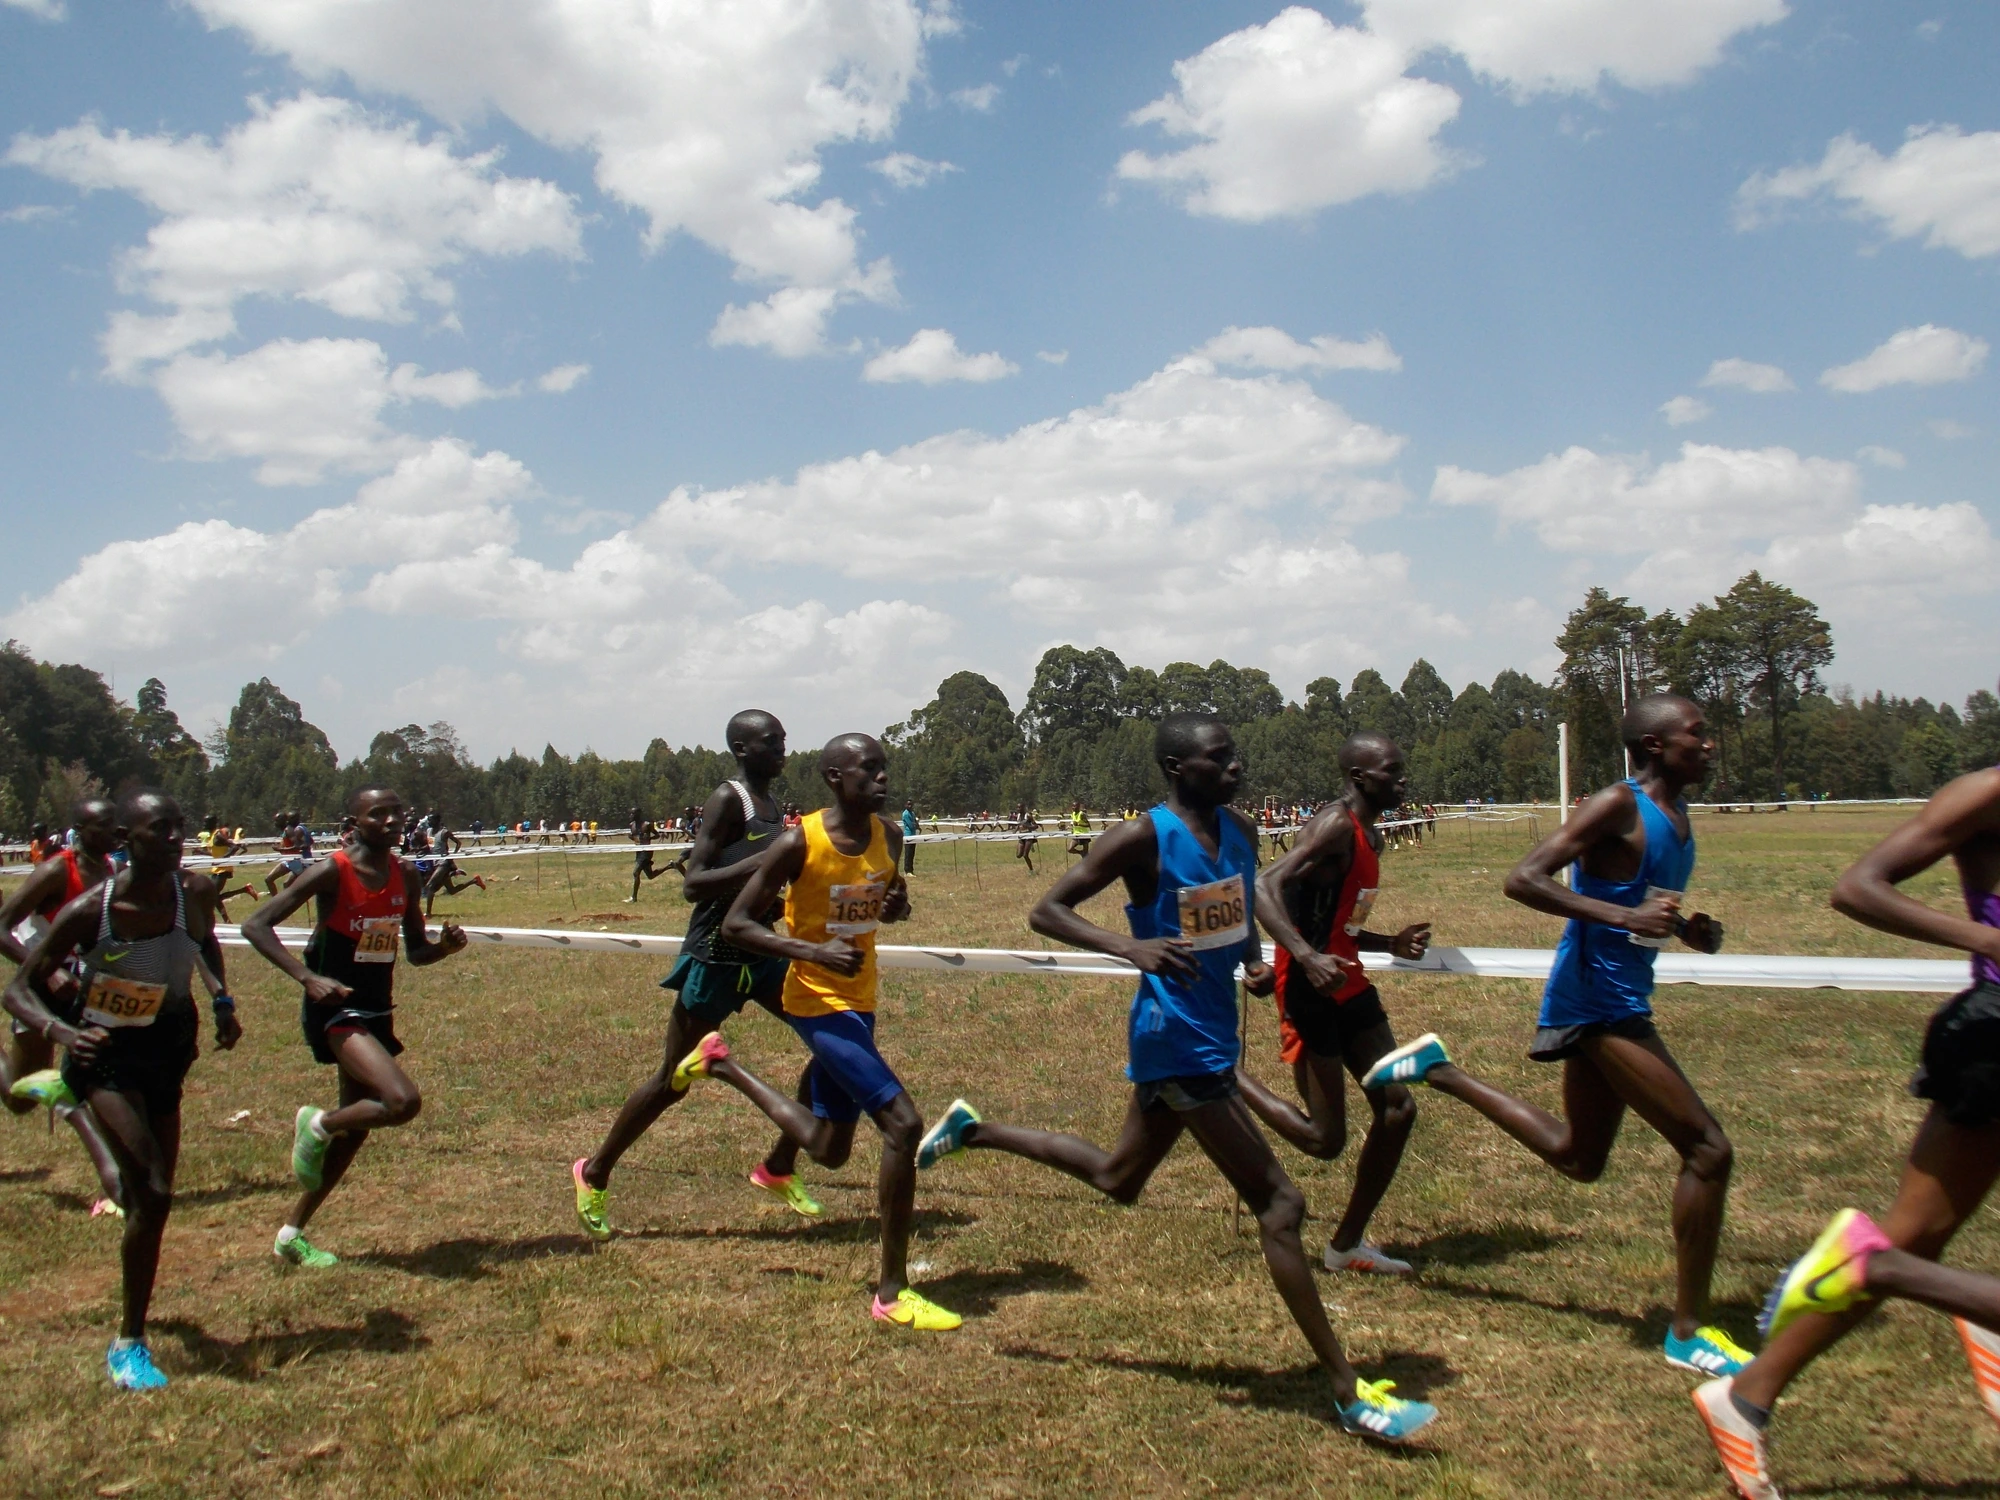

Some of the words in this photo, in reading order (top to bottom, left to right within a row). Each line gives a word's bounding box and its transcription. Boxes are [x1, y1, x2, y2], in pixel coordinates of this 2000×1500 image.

[836, 899, 878, 921] 1633
[1188, 897, 1243, 932] 1608
[96, 990, 156, 1016] 1597
